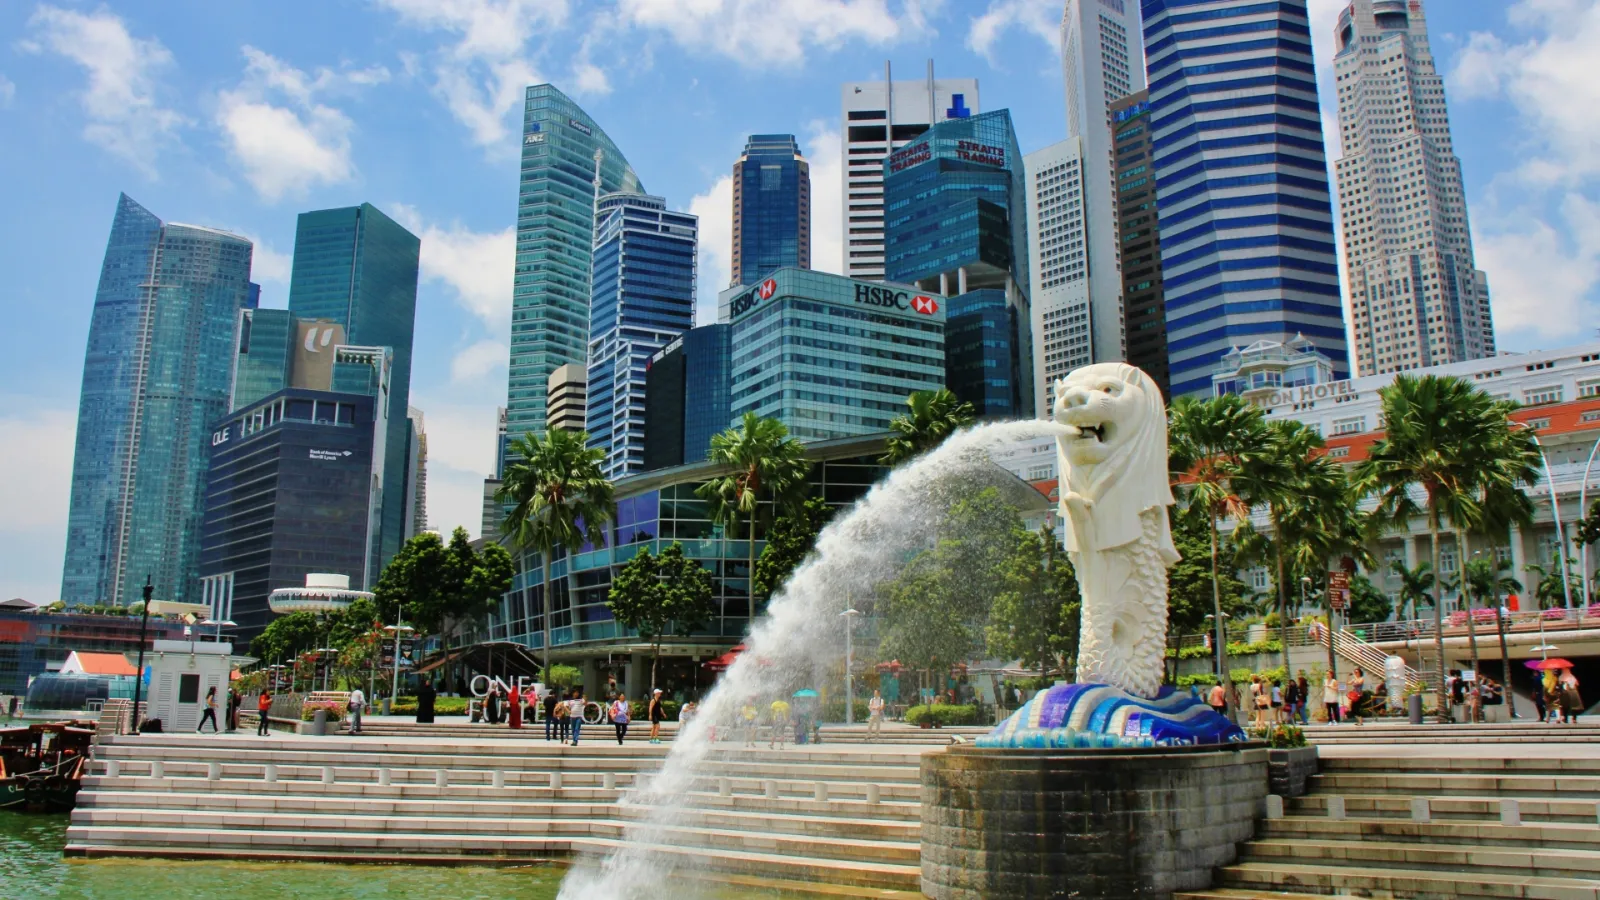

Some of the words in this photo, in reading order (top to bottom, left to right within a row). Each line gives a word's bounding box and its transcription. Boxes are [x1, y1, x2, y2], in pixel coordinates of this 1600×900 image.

[570, 120, 591, 135] Keppel
[525, 134, 545, 144] ANZ
[958, 140, 1004, 156] STRAITS
[889, 141, 930, 164] STRAITS
[890, 151, 932, 173] TRADING
[955, 150, 1005, 167] TRADING
[730, 287, 760, 319] HSBC
[854, 284, 908, 310] HSBC
[1300, 380, 1356, 401] HOTEL
[212, 427, 230, 446] OUE
[470, 675, 530, 697] ONE
